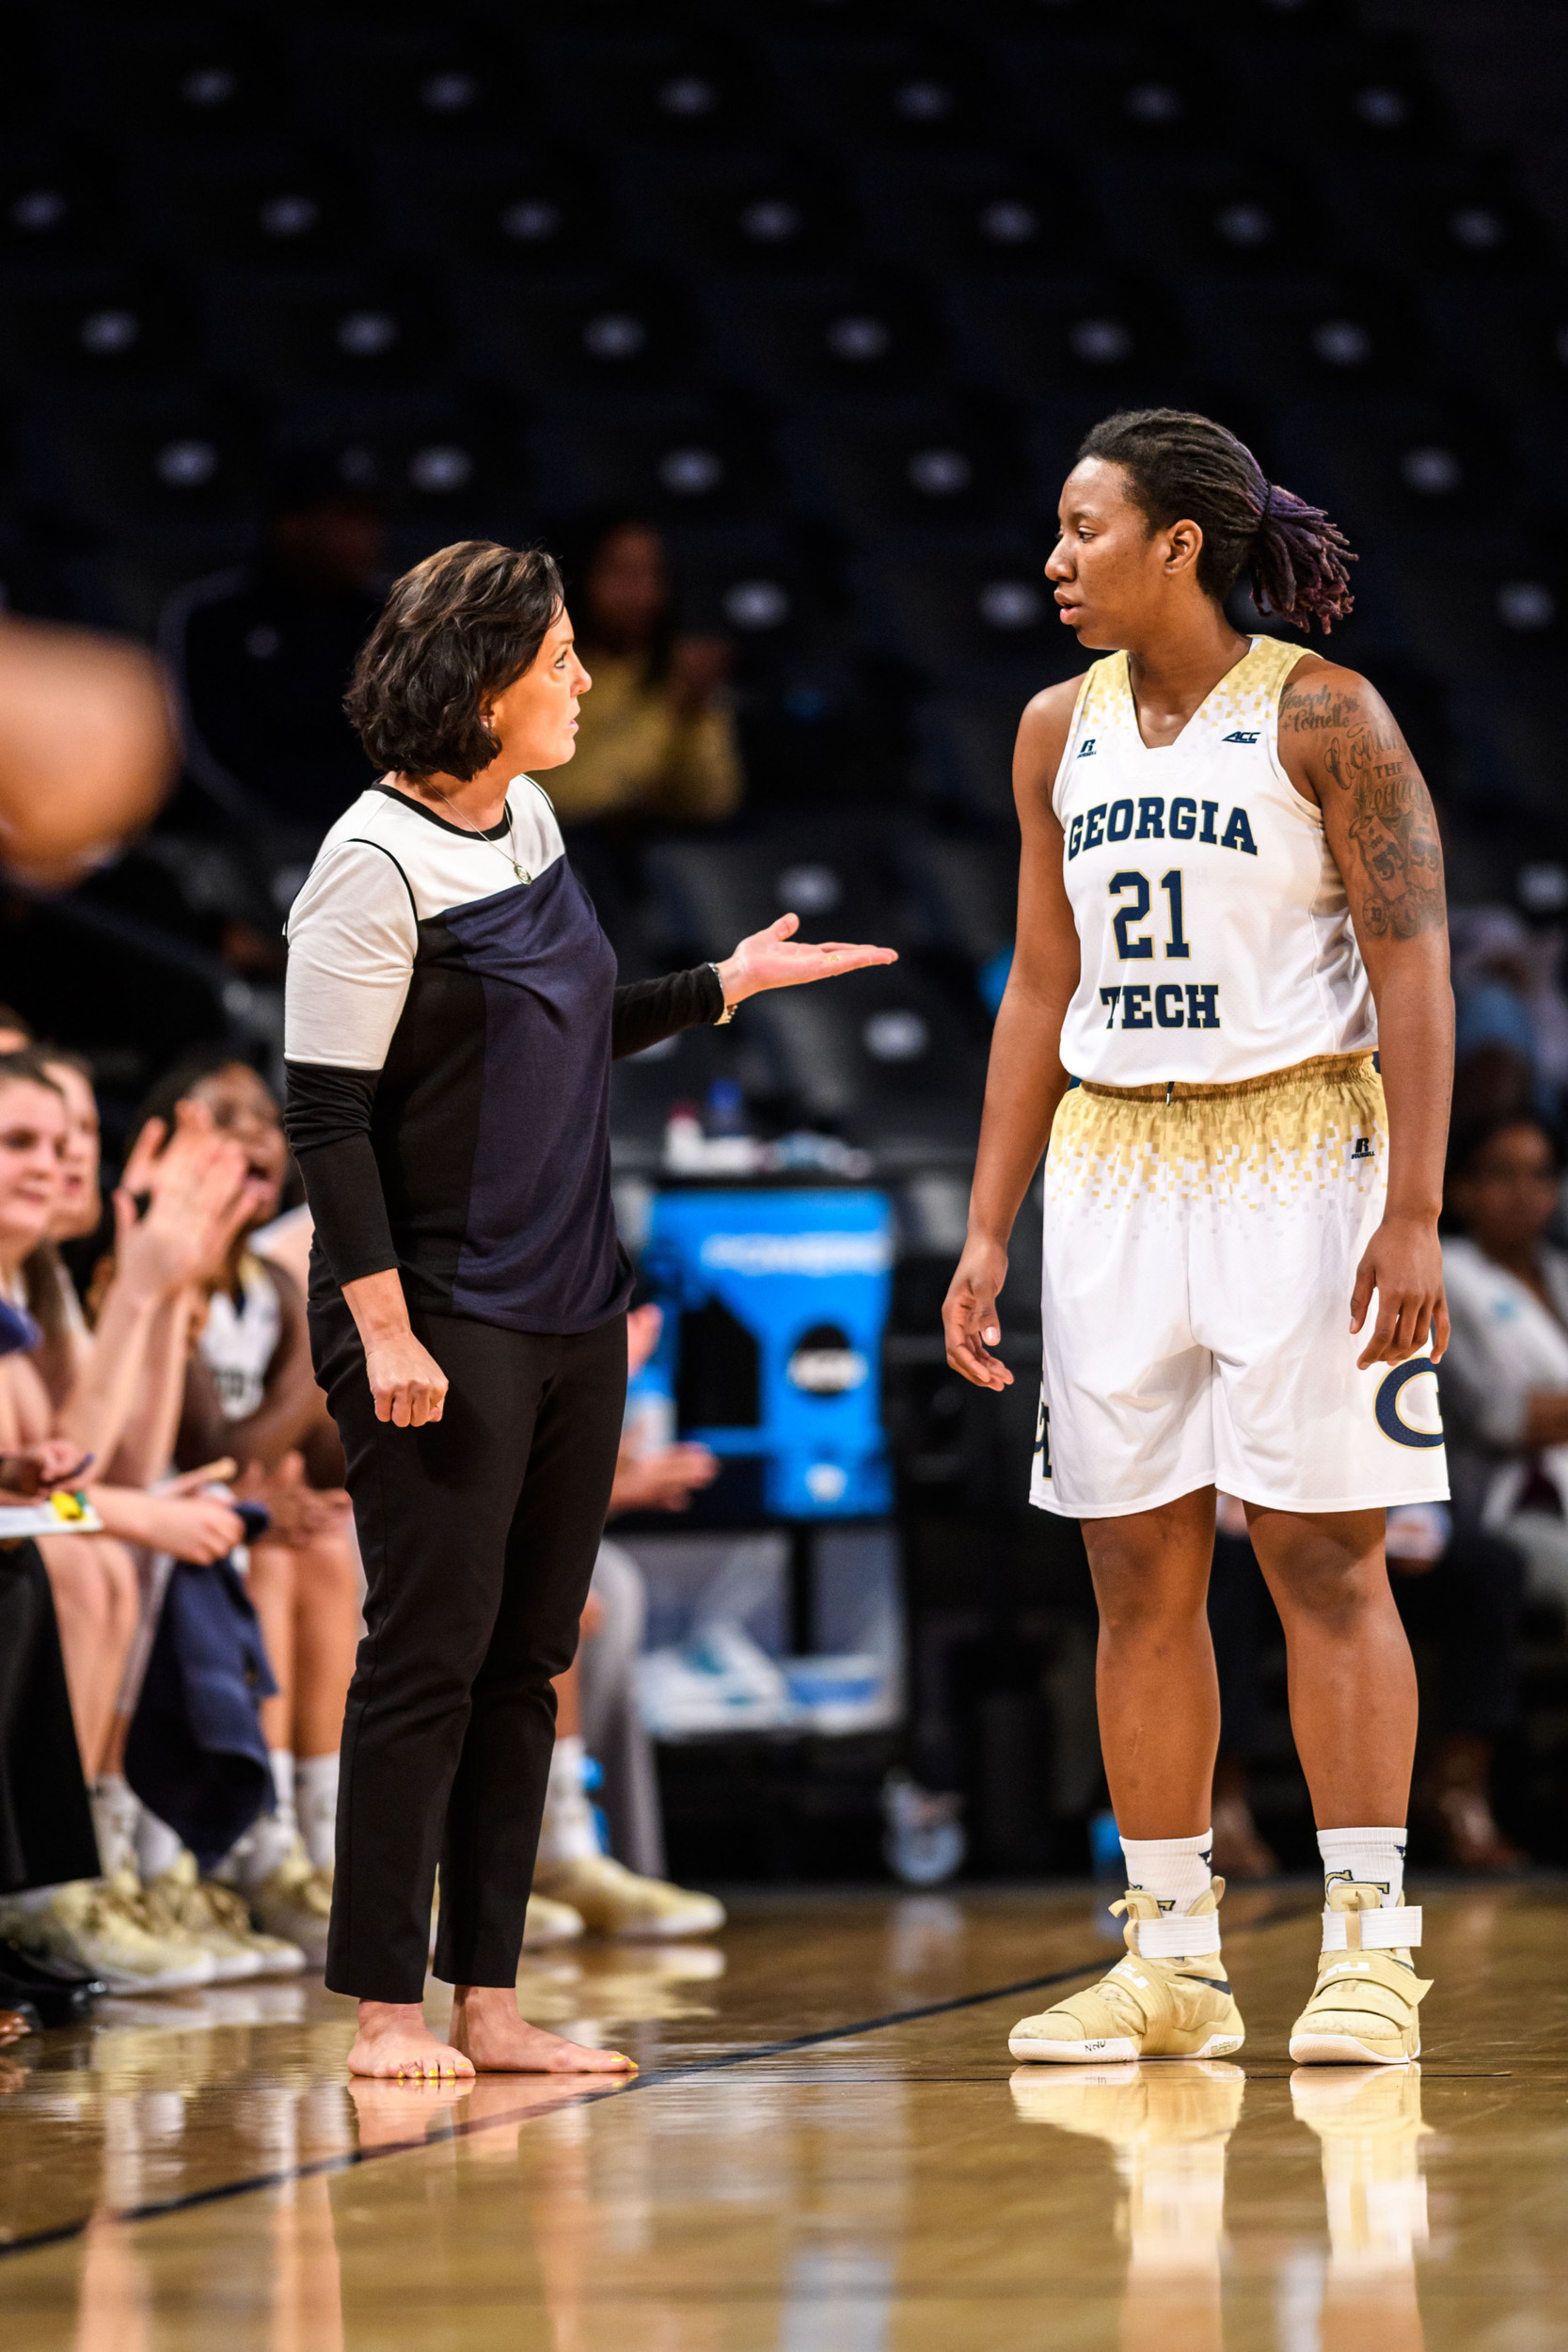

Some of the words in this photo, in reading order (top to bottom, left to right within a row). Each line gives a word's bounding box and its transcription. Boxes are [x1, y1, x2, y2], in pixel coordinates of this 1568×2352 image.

[1222, 731, 1261, 744] ACC
[1068, 796, 1259, 863] GEORGIA
[1107, 867, 1192, 962] 21
[1099, 984, 1221, 1030] TECH
